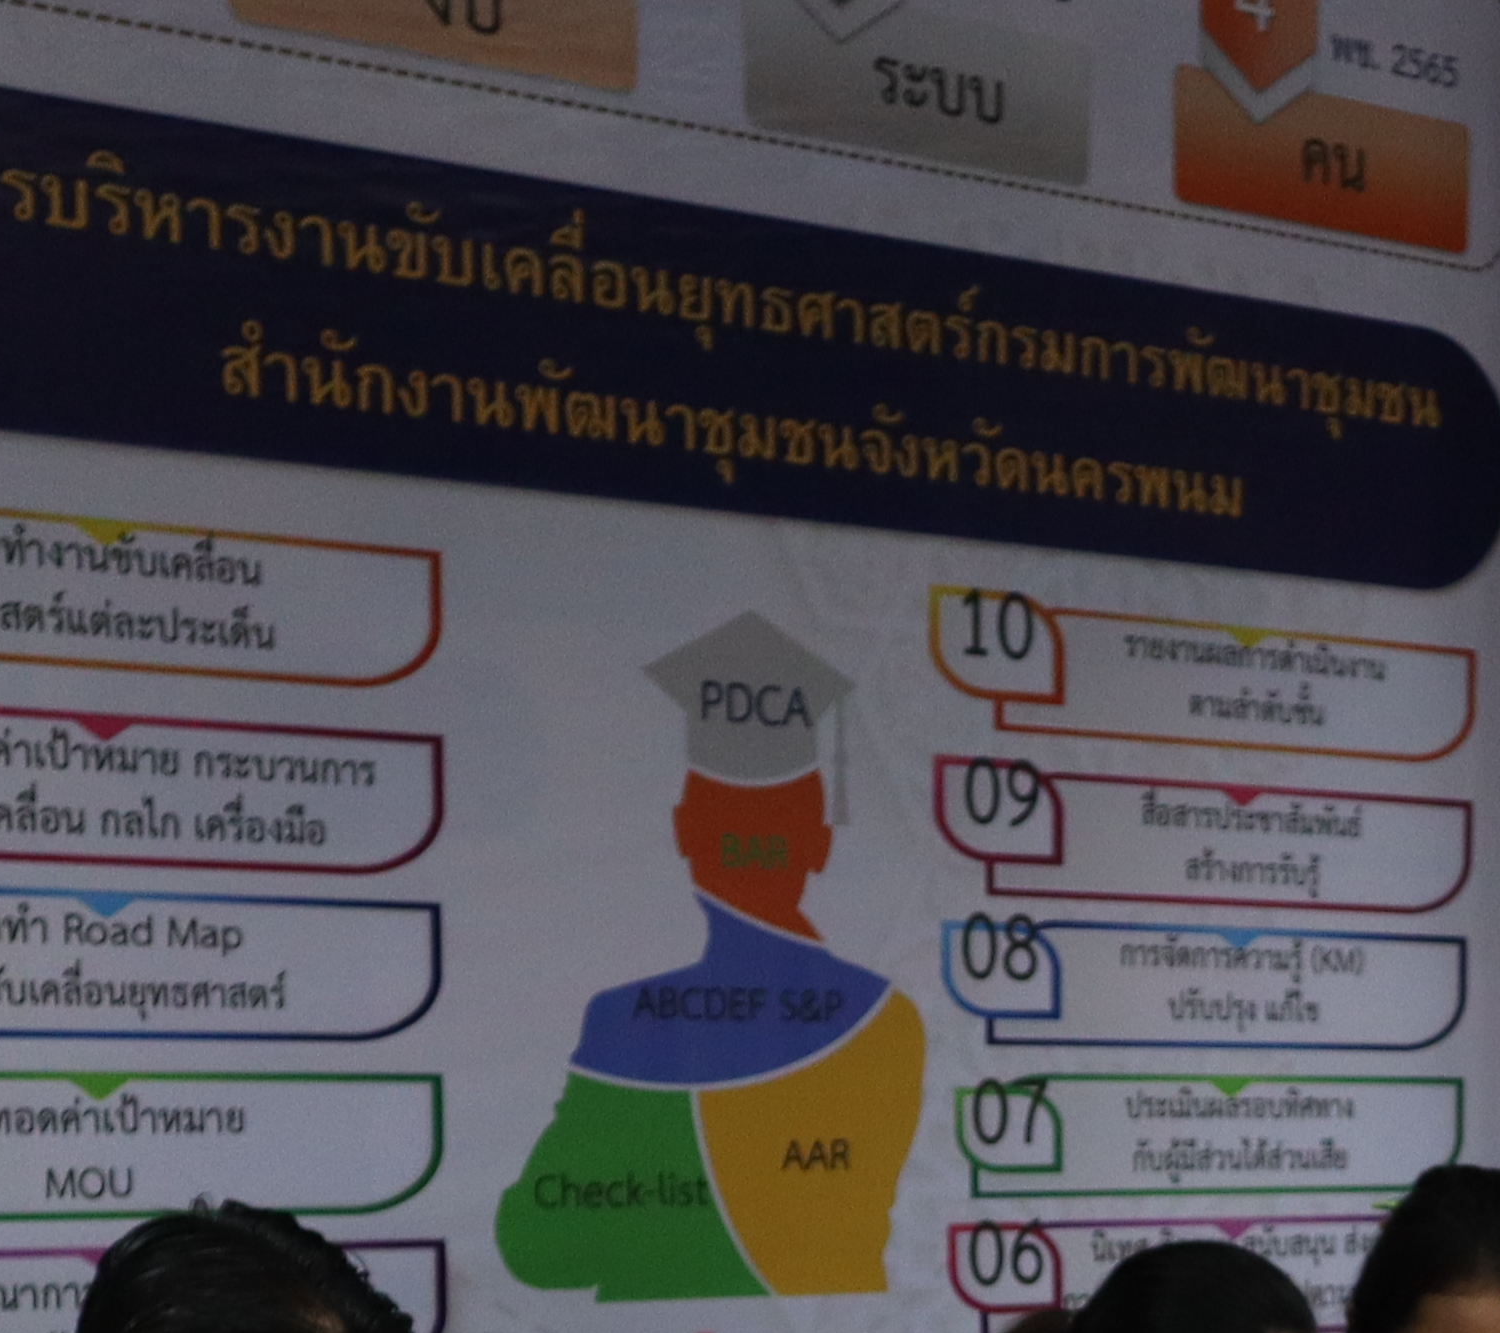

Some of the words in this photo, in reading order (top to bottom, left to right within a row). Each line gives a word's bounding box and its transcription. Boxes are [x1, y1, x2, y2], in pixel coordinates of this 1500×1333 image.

[1390, 44, 1459, 88] 2565
[872, 55, 1004, 125] ระบบ
[1302, 137, 1367, 192] คน
[220, 320, 1244, 519] สำนักงานพัฒนาชุมชนจังหวัดนครพนม
[962, 588, 1034, 660] 10
[700, 680, 813, 730] PDCA
[194, 750, 375, 789] กระบวนการ
[965, 757, 1040, 828] 09
[101, 803, 180, 842] กลไก
[196, 808, 326, 848] เครื่องมือ
[64, 912, 154, 949] Road
[168, 914, 243, 956] Map
[962, 912, 1039, 981] 08
[1311, 943, 1365, 976] (KM)
[632, 986, 766, 1021] ABCDEF
[780, 988, 844, 1023] S&P
[973, 1077, 1047, 1146] 07
[781, 1139, 852, 1172] AAR
[46, 1167, 135, 1199] MOU
[534, 1171, 710, 1211] Check-list
[968, 1218, 1044, 1286] 06
